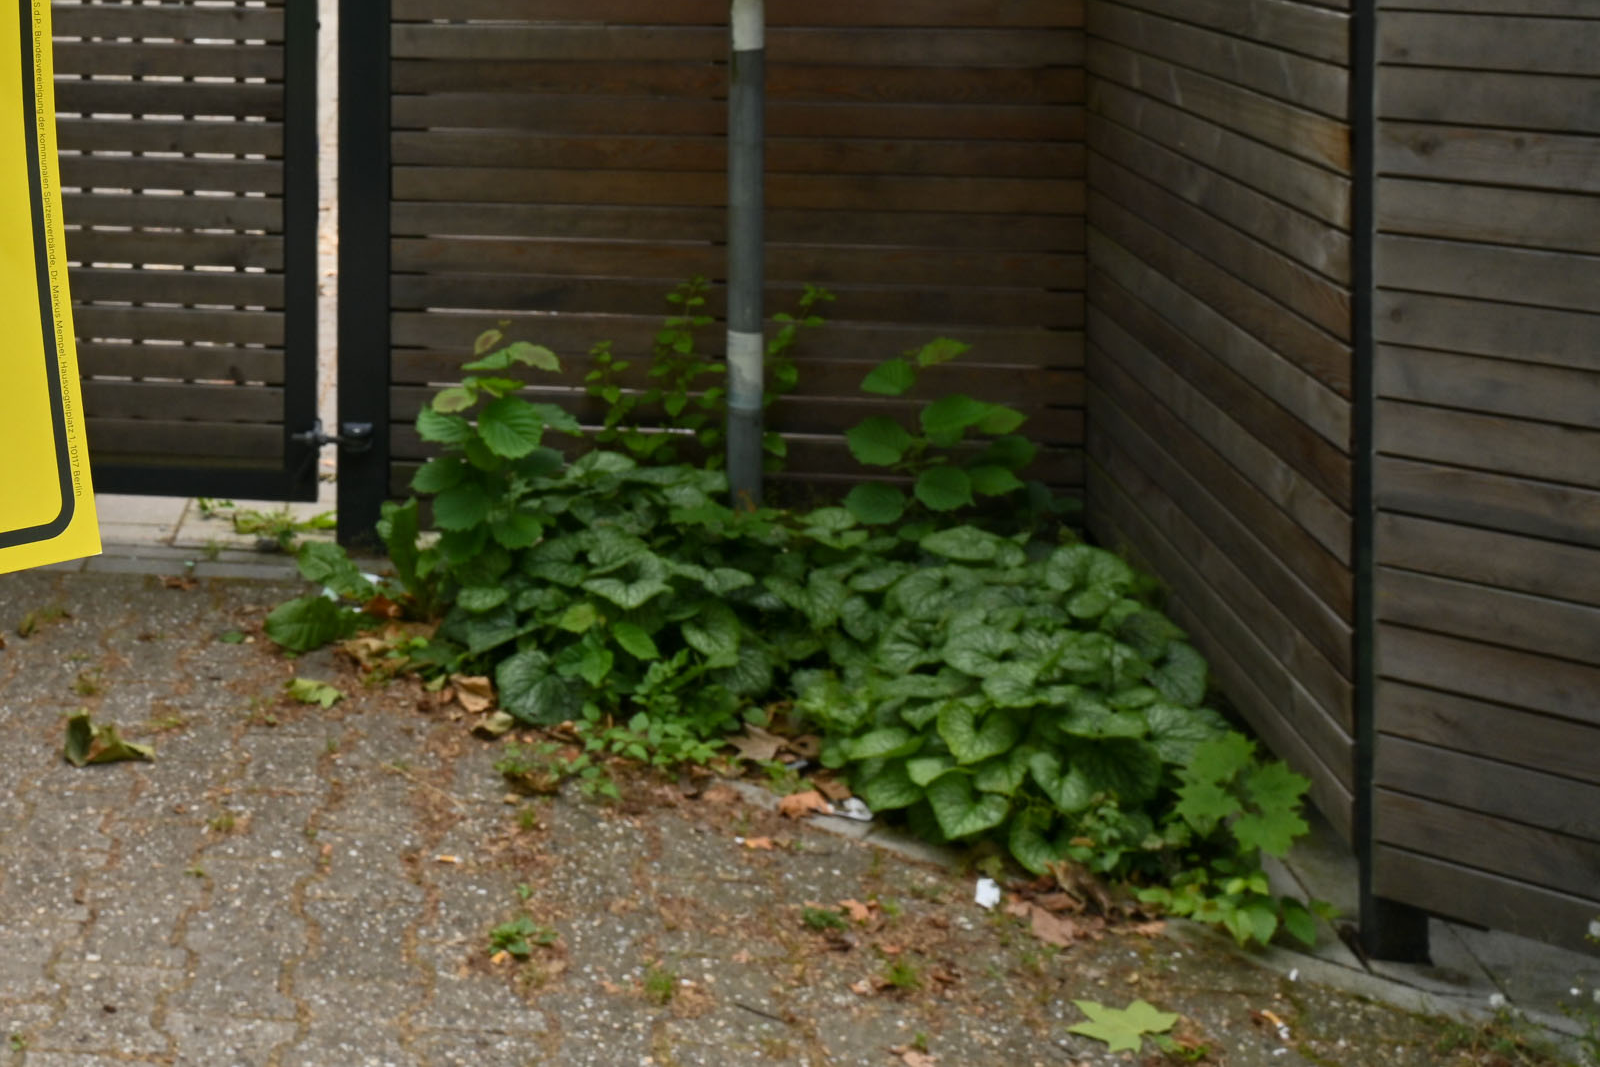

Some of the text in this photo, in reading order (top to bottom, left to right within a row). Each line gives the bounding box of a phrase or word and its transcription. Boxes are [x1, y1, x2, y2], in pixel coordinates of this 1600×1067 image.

[34, 30, 47, 115] Bundesvereinigung
[38, 116, 46, 131] der
[39, 133, 50, 189] kommunalen
[43, 191, 57, 268] Spitzenverbände,
[50, 270, 59, 284] Dr.
[52, 285, 62, 318] Markus
[60, 361, 75, 433] Hausvogteiplatz
[70, 445, 80, 468] 10117
[73, 470, 83, 497] Berlin
